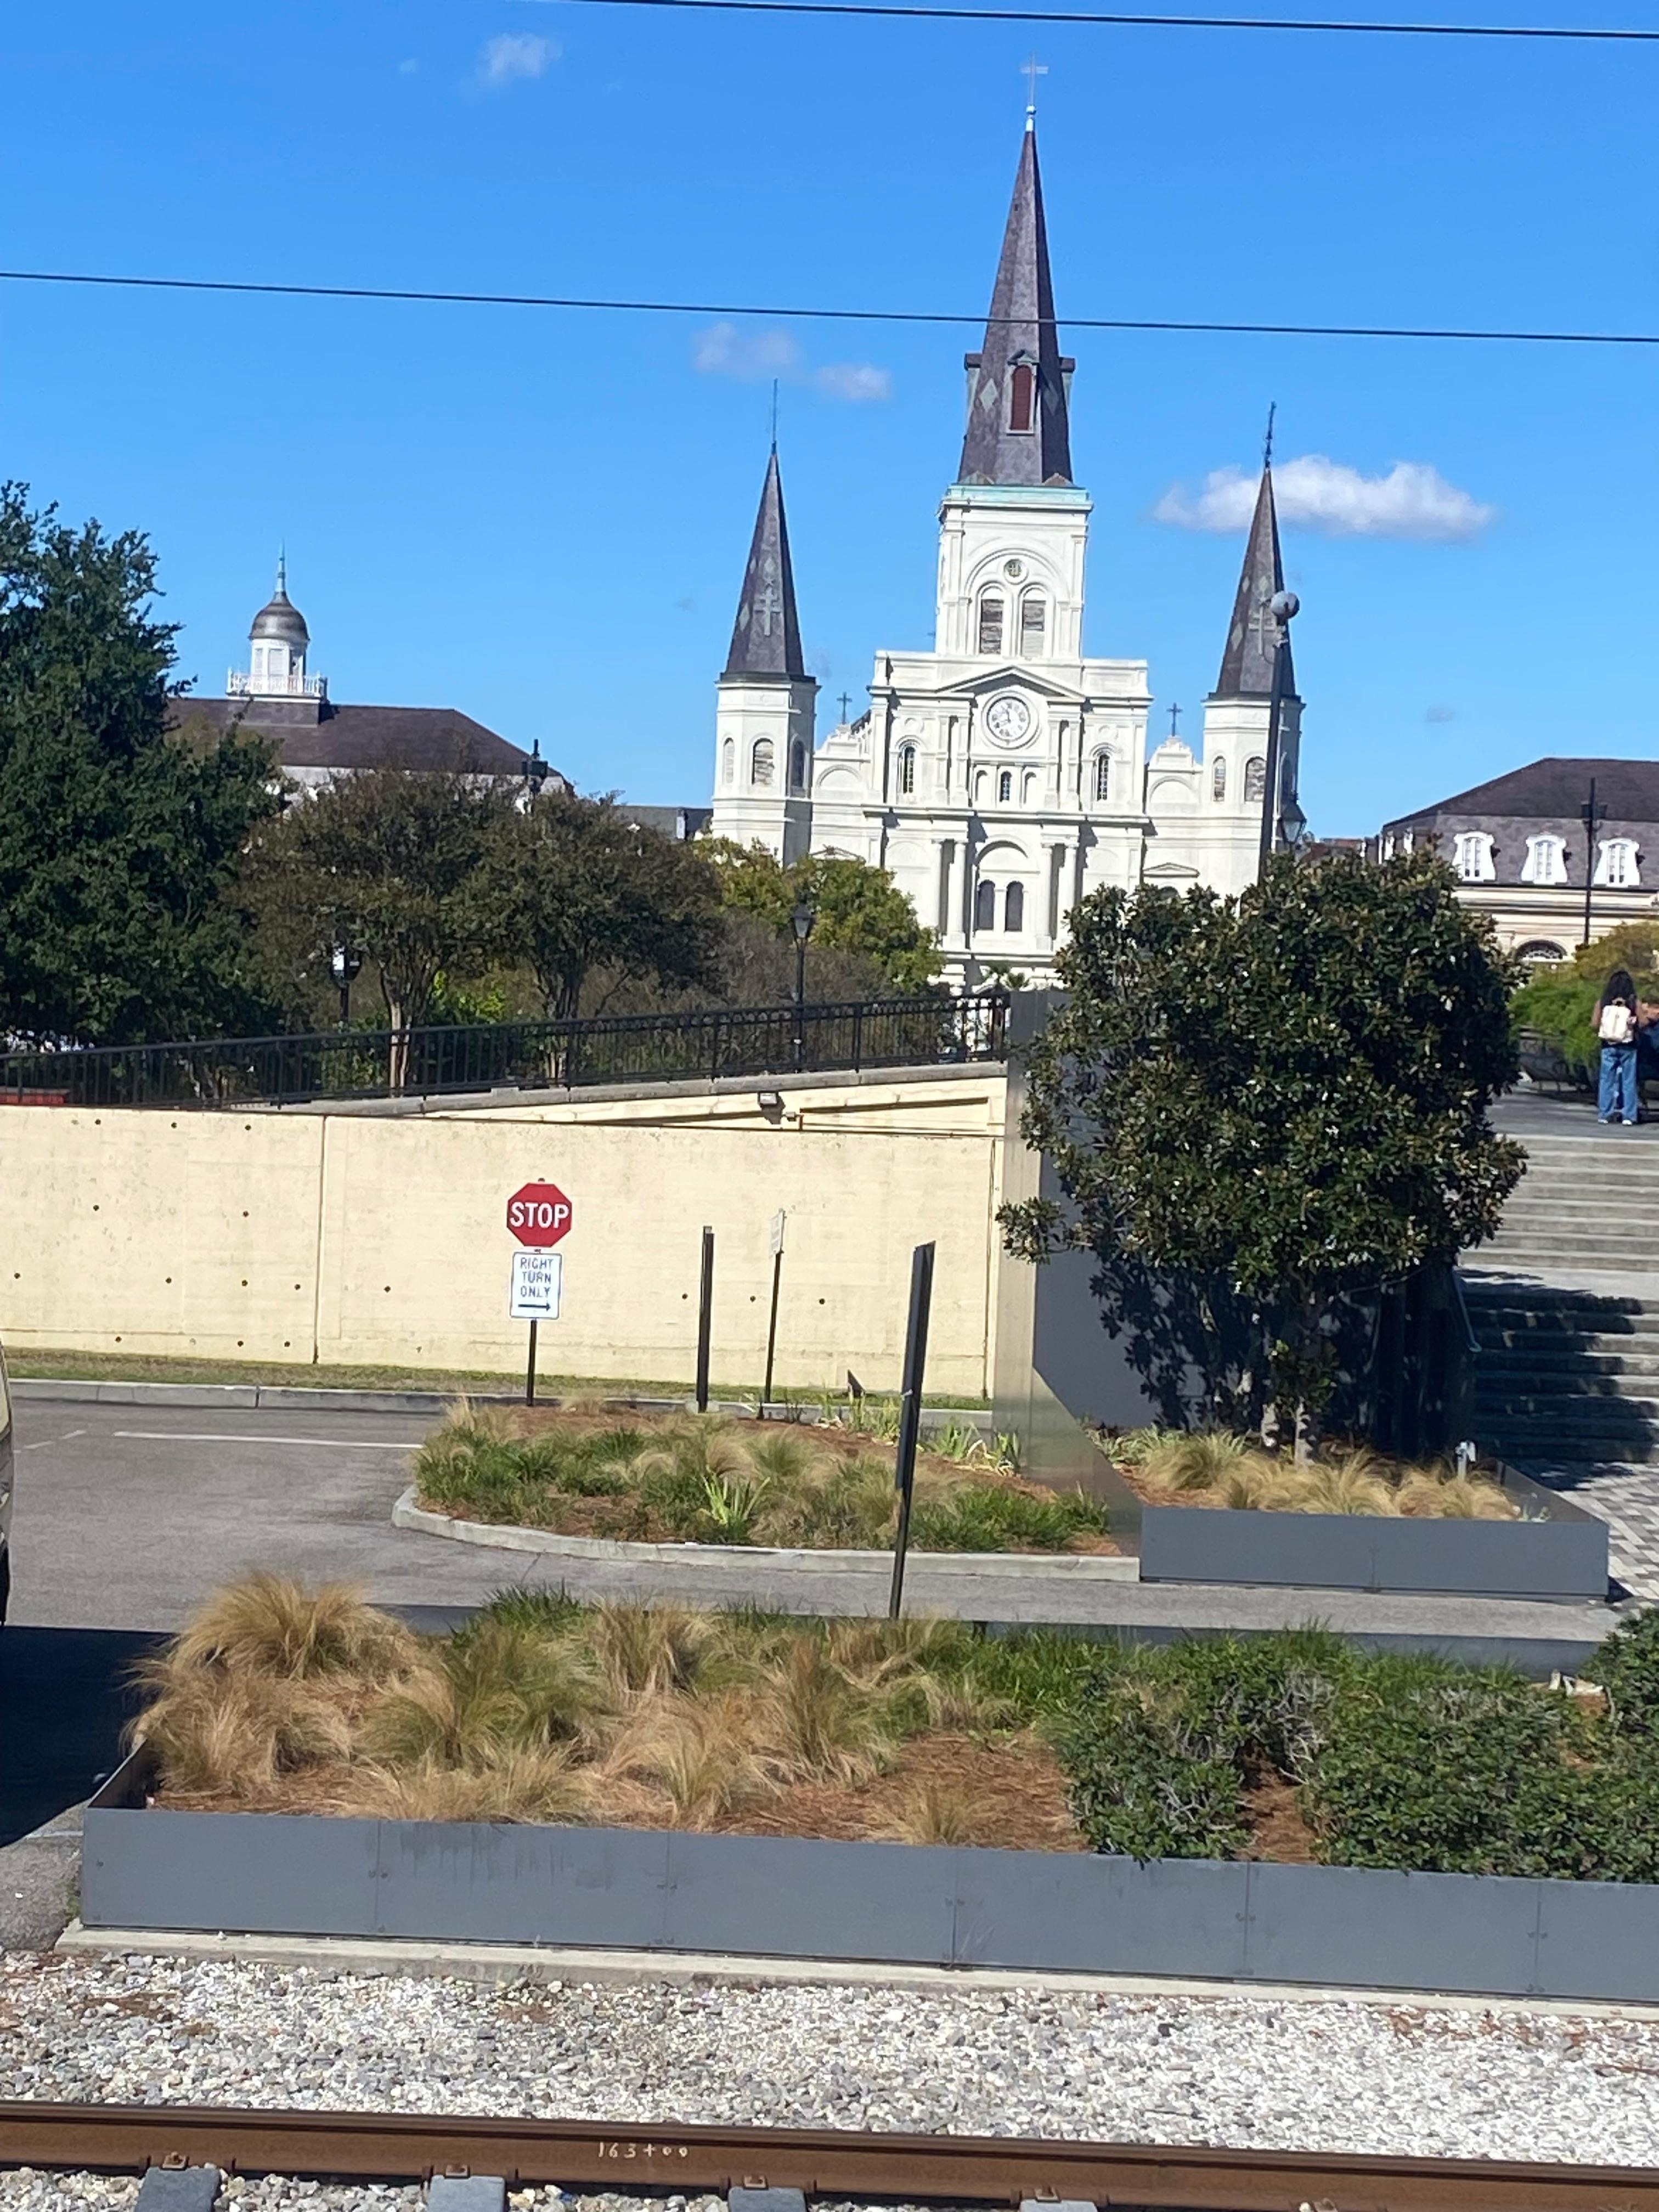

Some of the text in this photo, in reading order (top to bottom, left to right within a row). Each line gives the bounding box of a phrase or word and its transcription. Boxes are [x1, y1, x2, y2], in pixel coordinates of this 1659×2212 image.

[510, 1201, 569, 1229] STOP
[520, 1257, 554, 1269] RIGHT
[522, 1271, 551, 1284] TURN
[521, 1285, 551, 1298] ONLY
